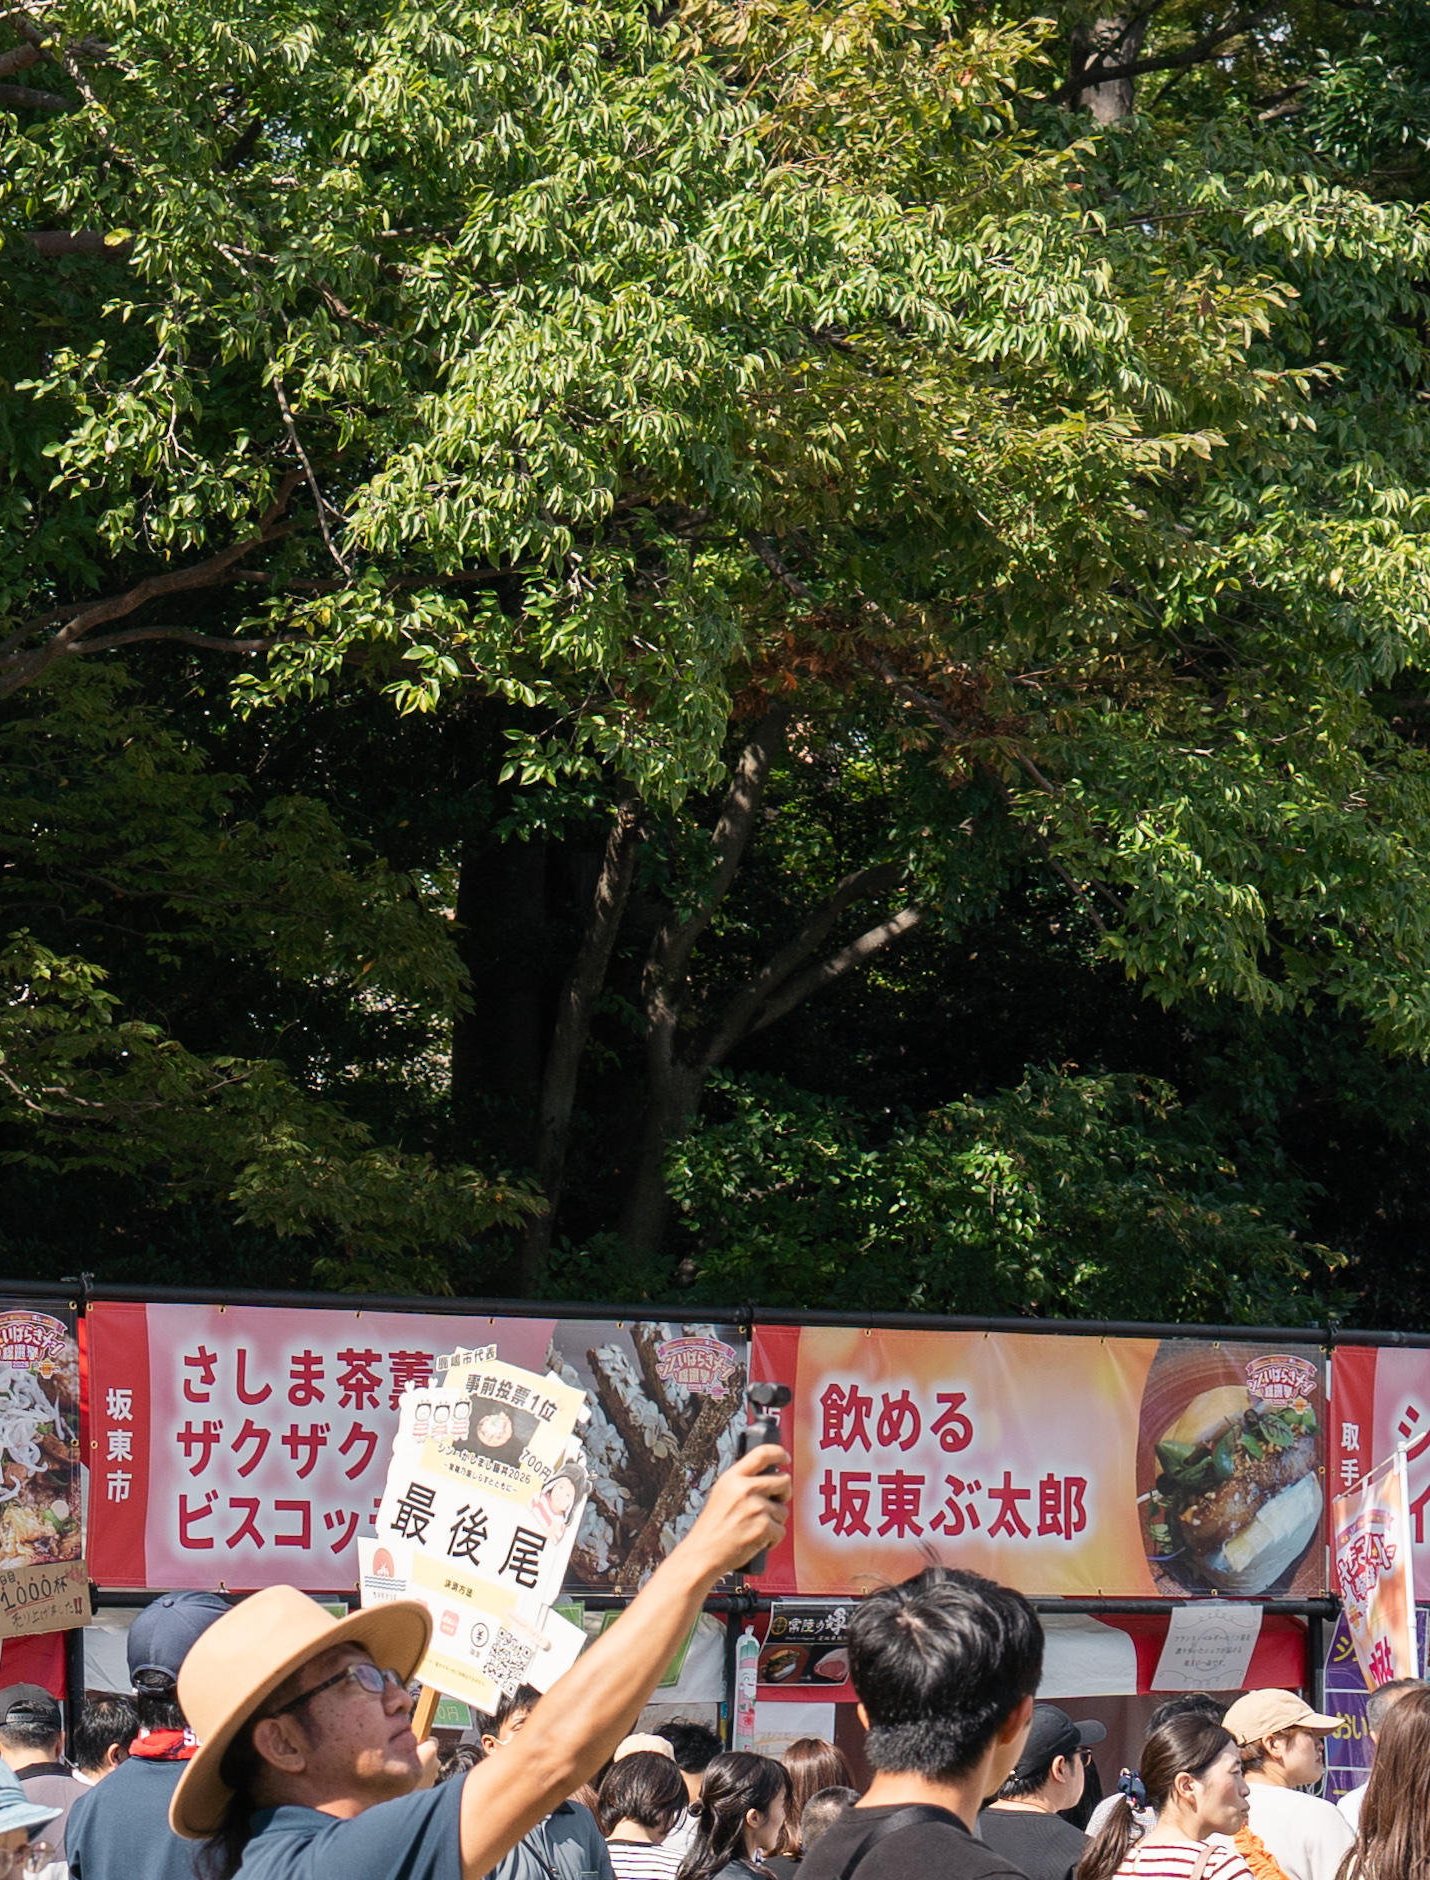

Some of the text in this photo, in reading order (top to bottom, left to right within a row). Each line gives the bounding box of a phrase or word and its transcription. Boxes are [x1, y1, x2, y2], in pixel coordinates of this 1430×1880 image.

[182, 1345, 435, 1411] さしま茶薫
[465, 1373, 558, 1422] 事前投票1位
[106, 1388, 134, 1503] 坂東市
[820, 1384, 974, 1453] 飲める
[176, 1422, 380, 1479] ザクザク
[520, 1450, 553, 1482] 700円
[176, 1494, 380, 1552] ビスコッ
[389, 1481, 547, 1590] 最後尾
[819, 1470, 1087, 1541] 坂東ぶ太郎
[0, 1576, 68, 1612] 1000杯
